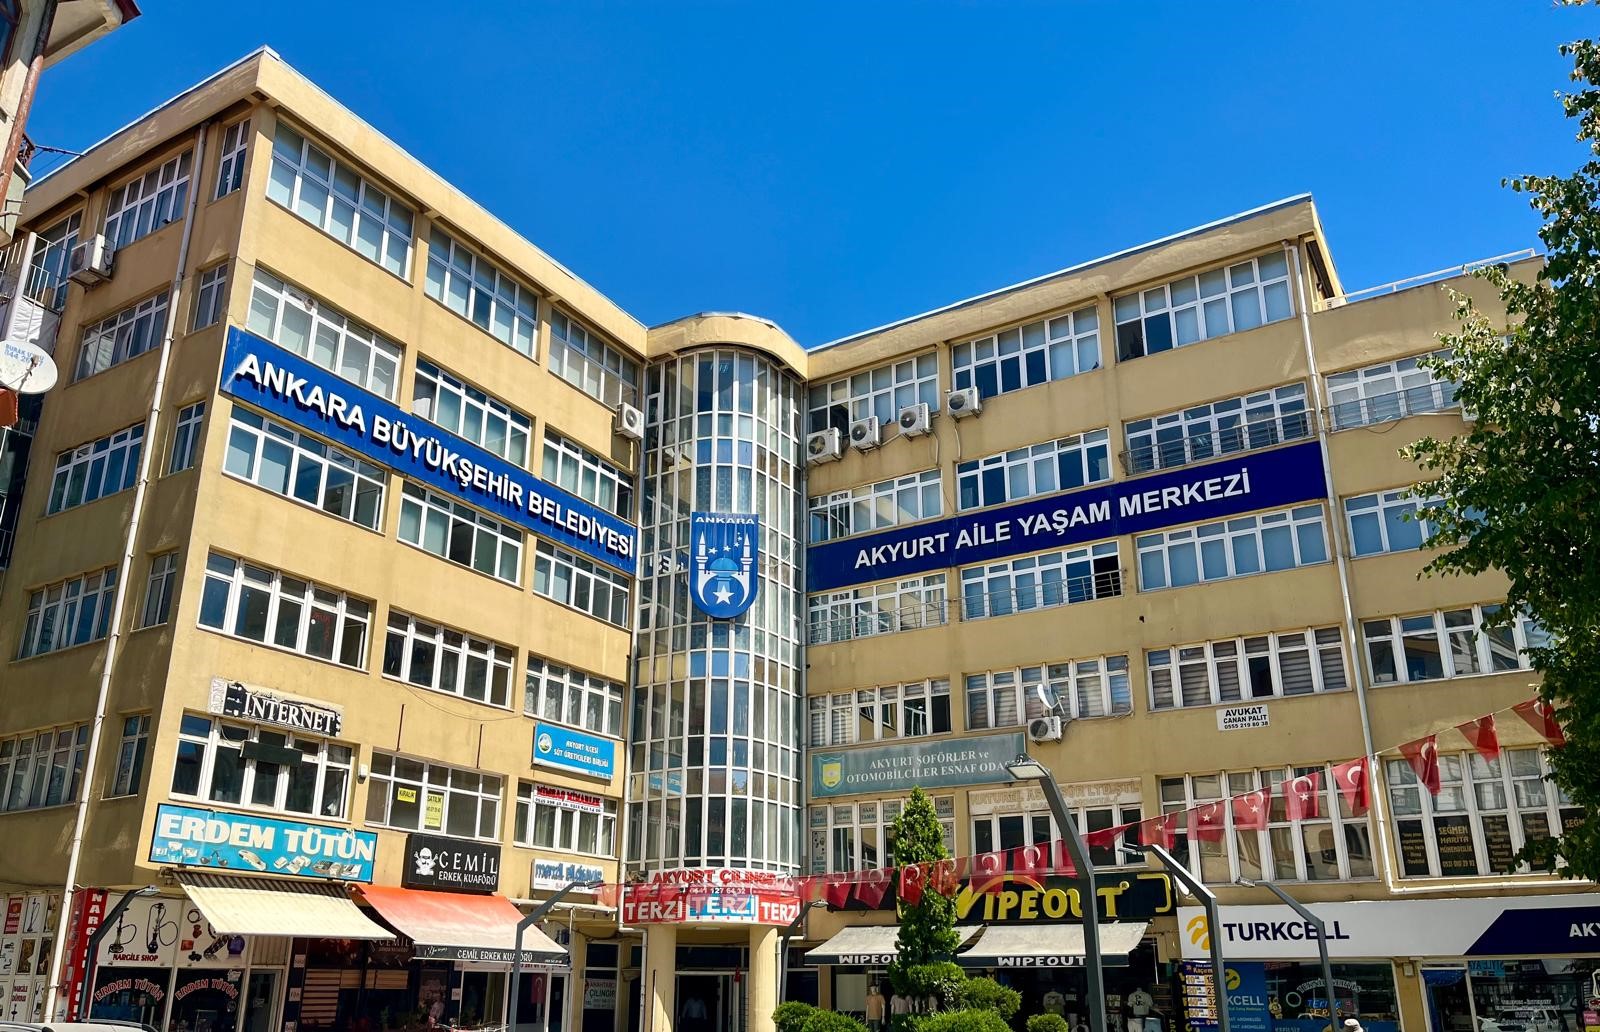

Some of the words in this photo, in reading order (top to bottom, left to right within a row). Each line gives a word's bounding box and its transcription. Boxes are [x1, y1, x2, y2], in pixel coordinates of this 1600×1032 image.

[235, 353, 366, 433] ANKARA
[372, 414, 523, 507] BÜYÜKŞEHİR
[528, 489, 634, 559] BELEDİYESİ
[695, 515, 756, 526] ANKARA
[854, 532, 950, 570] AKYURT
[955, 521, 1011, 552] AİLE
[1018, 499, 1112, 536] YAŞAM
[1119, 467, 1252, 518] MERKEZİ
[1223, 716, 1247, 724] CANAN
[1225, 706, 1263, 717] AVUKAT
[869, 754, 914, 770] AKYURT
[978, 751, 990, 759] ve
[941, 763, 977, 777] ESNAF
[979, 759, 1008, 773] ODA
[1565, 817, 1585, 828] SEĞM
[158, 812, 276, 851] ERDEM
[284, 826, 375, 862] TÜTÜN
[438, 850, 498, 875] CEMİL
[438, 870, 462, 882] ERKEK
[463, 874, 497, 886] KUAFÖRÜ
[652, 869, 715, 886] AKYURT
[625, 896, 682, 921] TERZİ
[690, 893, 755, 915] TERZİ
[1222, 920, 1350, 942] TURKCELL
[112, 952, 140, 962] NARGİLE
[141, 954, 159, 962] SHOP
[457, 948, 479, 960] CEMİL
[480, 950, 501, 961] ERKEK
[502, 952, 533, 963] KUAÖRÜ
[838, 954, 901, 964] WIPEOU
[997, 956, 1087, 967] WIPEOUT
[94, 978, 132, 1001] ERDEM
[134, 977, 165, 1001] TÜTÜN
[175, 978, 209, 1001] ERDEM
[211, 977, 239, 1000] TÜTÜN
[1227, 995, 1265, 1006] KCELL
